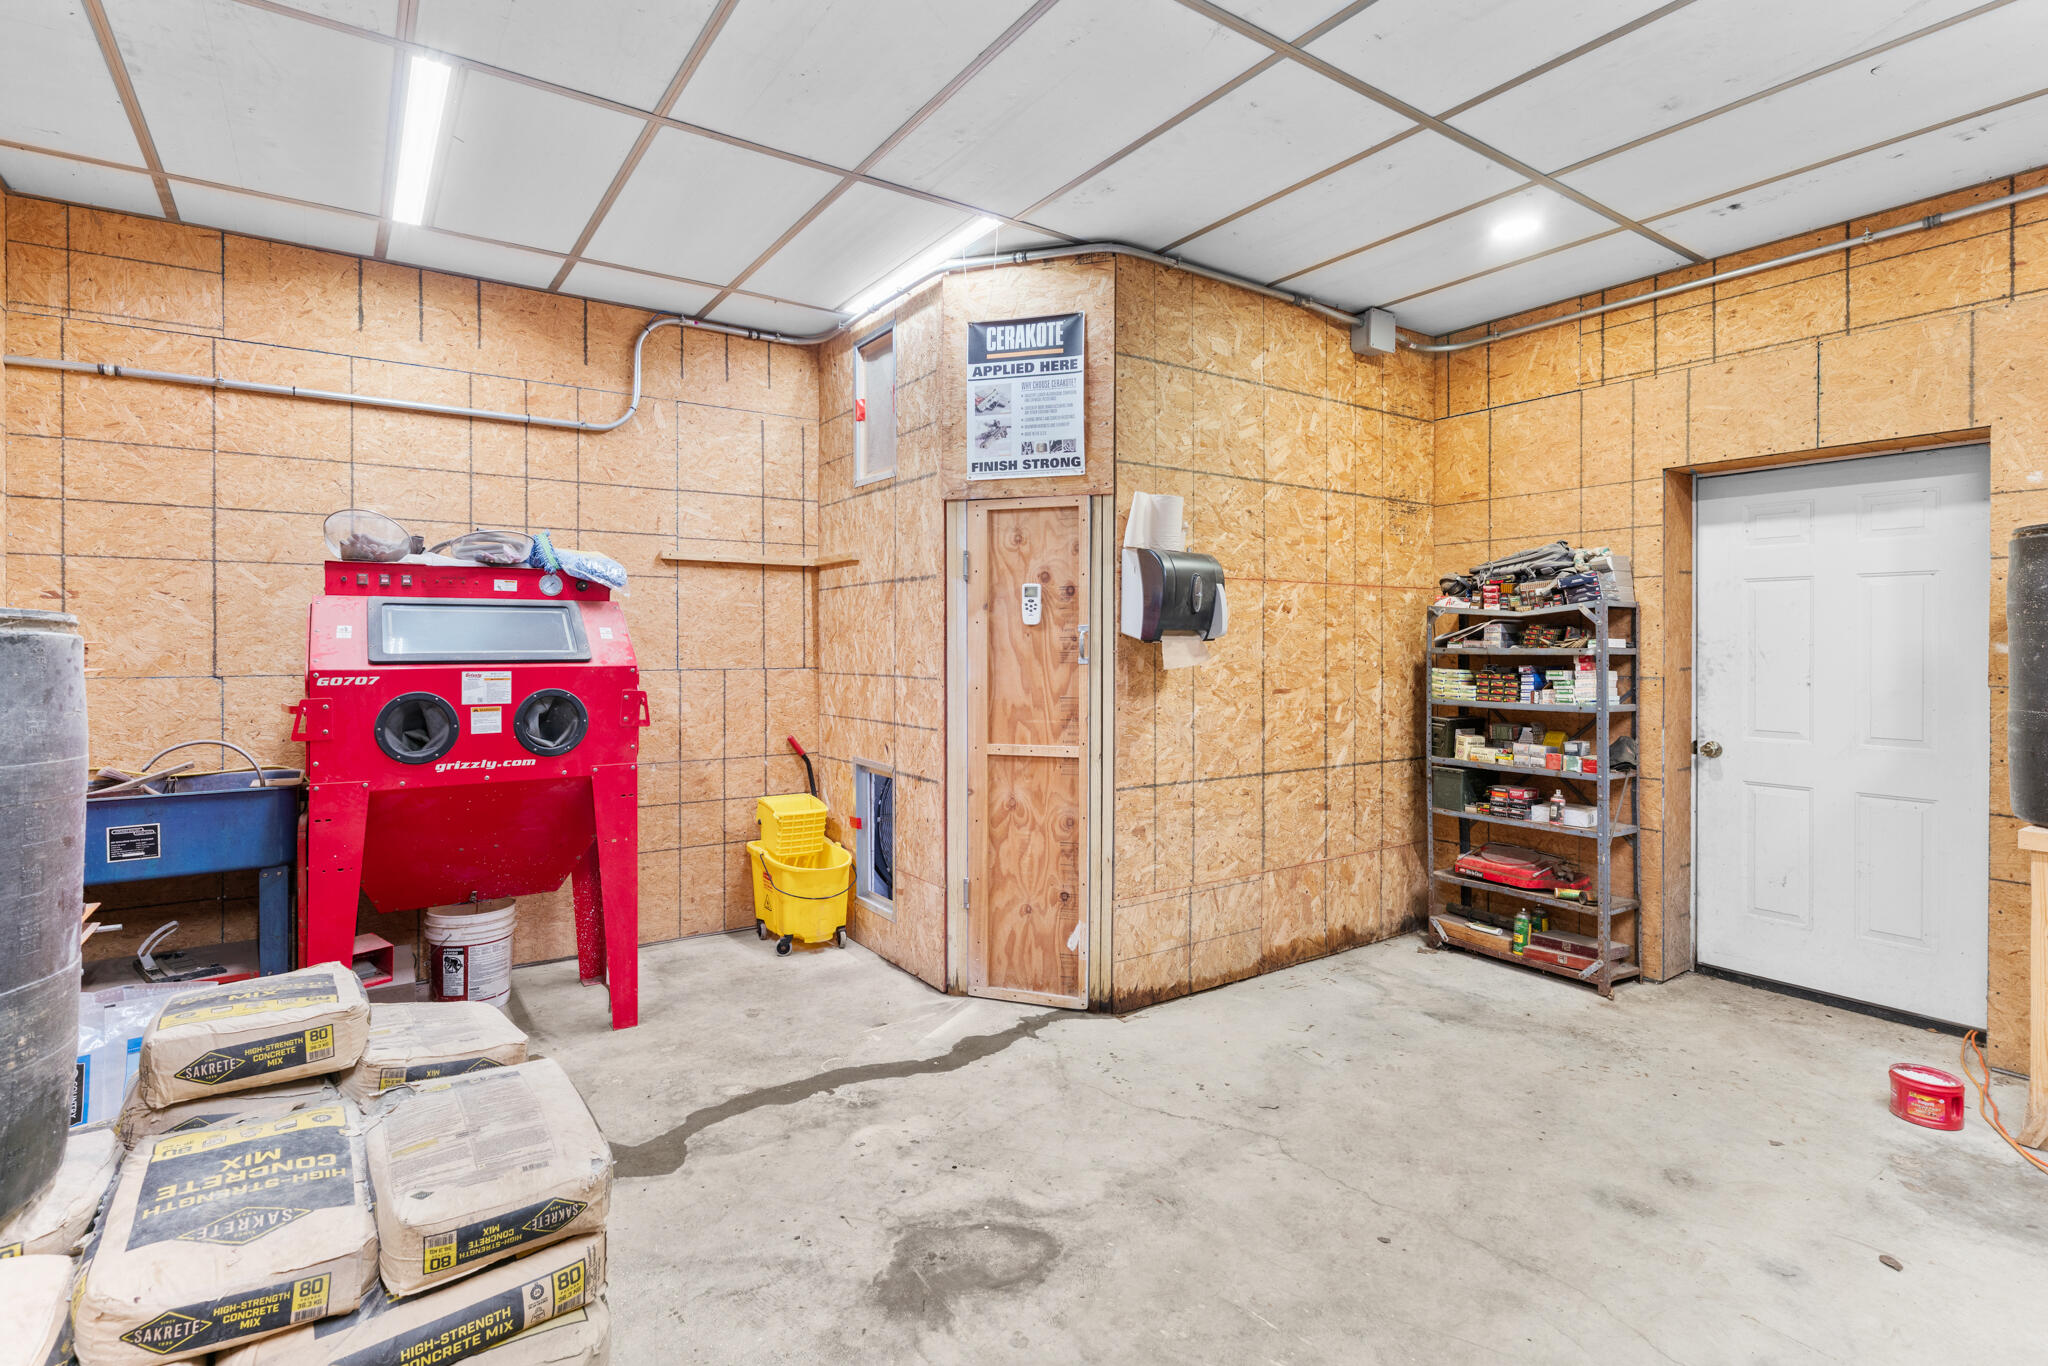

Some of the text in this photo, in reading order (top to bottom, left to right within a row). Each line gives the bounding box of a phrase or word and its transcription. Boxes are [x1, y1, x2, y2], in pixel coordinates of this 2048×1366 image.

[986, 320, 1064, 352] CERAKOTE
[972, 359, 1078, 377] APPLIED HERE
[971, 461, 1018, 473] FINISH
[1022, 457, 1081, 470] STRONG
[435, 758, 536, 773] grizzly.com
[309, 1028, 328, 1042] 80
[244, 1037, 304, 1056] HIGH-STRENGTH
[252, 1047, 296, 1062] CONCRETE
[185, 1058, 237, 1080] SAKRETE
[267, 1058, 283, 1067] MIX
[426, 1070, 440, 1078] MIX
[221, 1148, 281, 1172] MIX
[155, 1153, 337, 1201] CONCRETE
[142, 1167, 346, 1220] HIGH-STRENGTH
[196, 1208, 293, 1240] SAKRETE
[531, 1203, 579, 1231] SAKRETE
[468, 1228, 515, 1249] CONCRETE
[483, 1224, 500, 1237] MIX
[459, 1234, 522, 1260] HIGH-STRENGTH
[429, 1255, 451, 1270] 80
[299, 1277, 323, 1298] 80
[557, 1265, 581, 1289] 80
[213, 1290, 291, 1317] HIGH-STRENGTH
[222, 1303, 280, 1324] CONCRETE
[133, 1320, 201, 1345] SAKRETE
[239, 1317, 261, 1330] MIX
[400, 1306, 512, 1362] HIGH-STRENGTH
[485, 1320, 514, 1344] MIX
